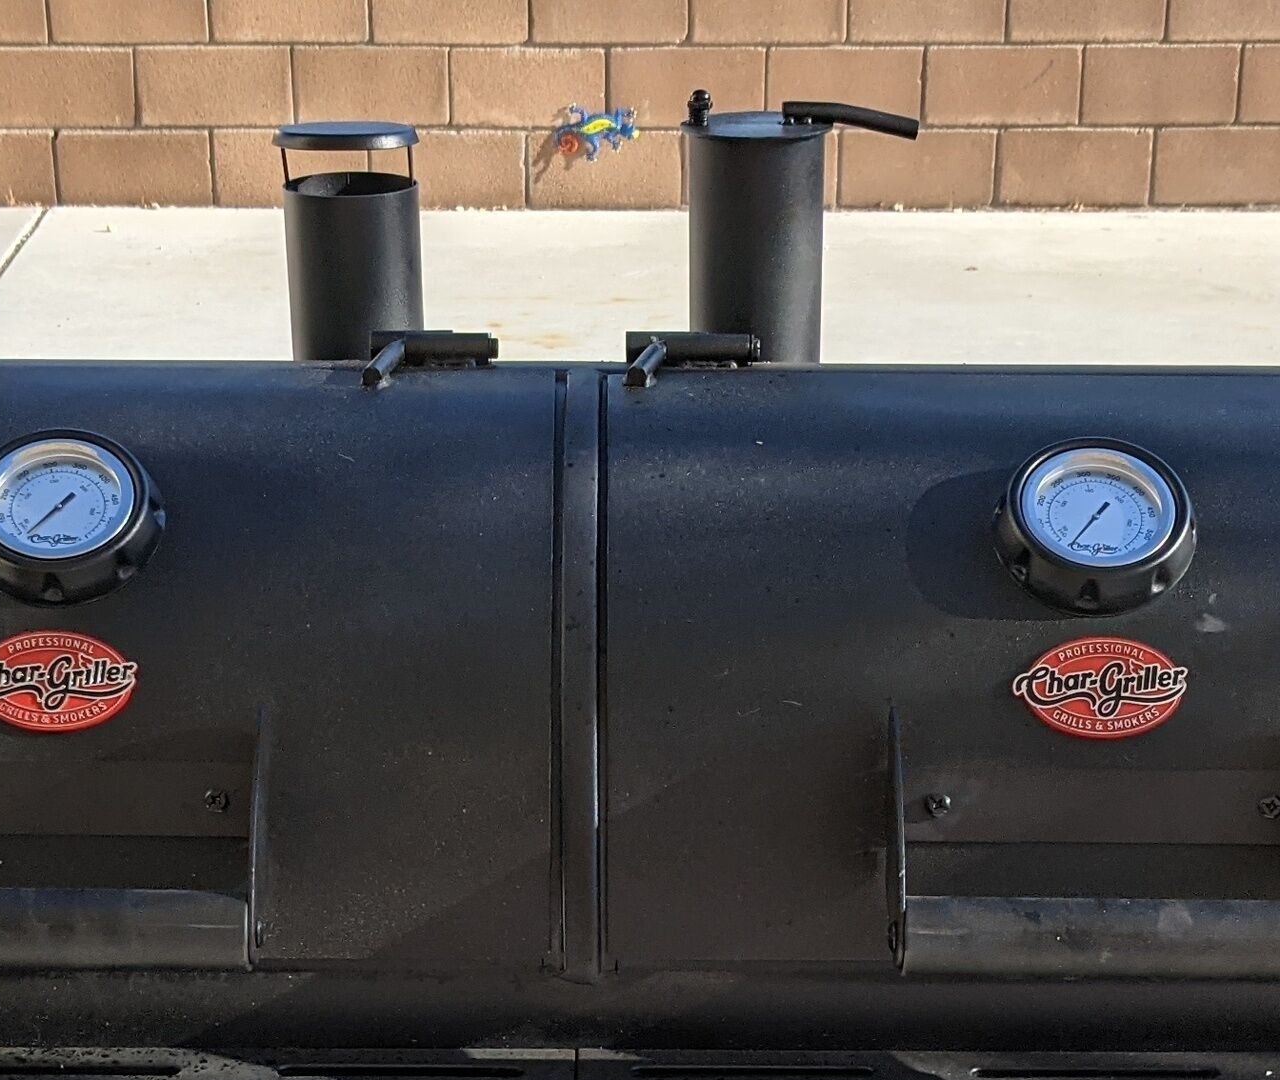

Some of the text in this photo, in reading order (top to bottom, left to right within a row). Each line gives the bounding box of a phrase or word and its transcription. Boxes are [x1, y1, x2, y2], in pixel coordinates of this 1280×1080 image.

[8, 637, 94, 654] PROFESSIONAL
[1058, 643, 1145, 661] PROFESSIONAL
[1012, 661, 1188, 720] Char-Griller
[41, 714, 50, 723] &
[54, 701, 107, 724] SMOKERS
[1053, 707, 1160, 730] GRILLS & SMOKERS
